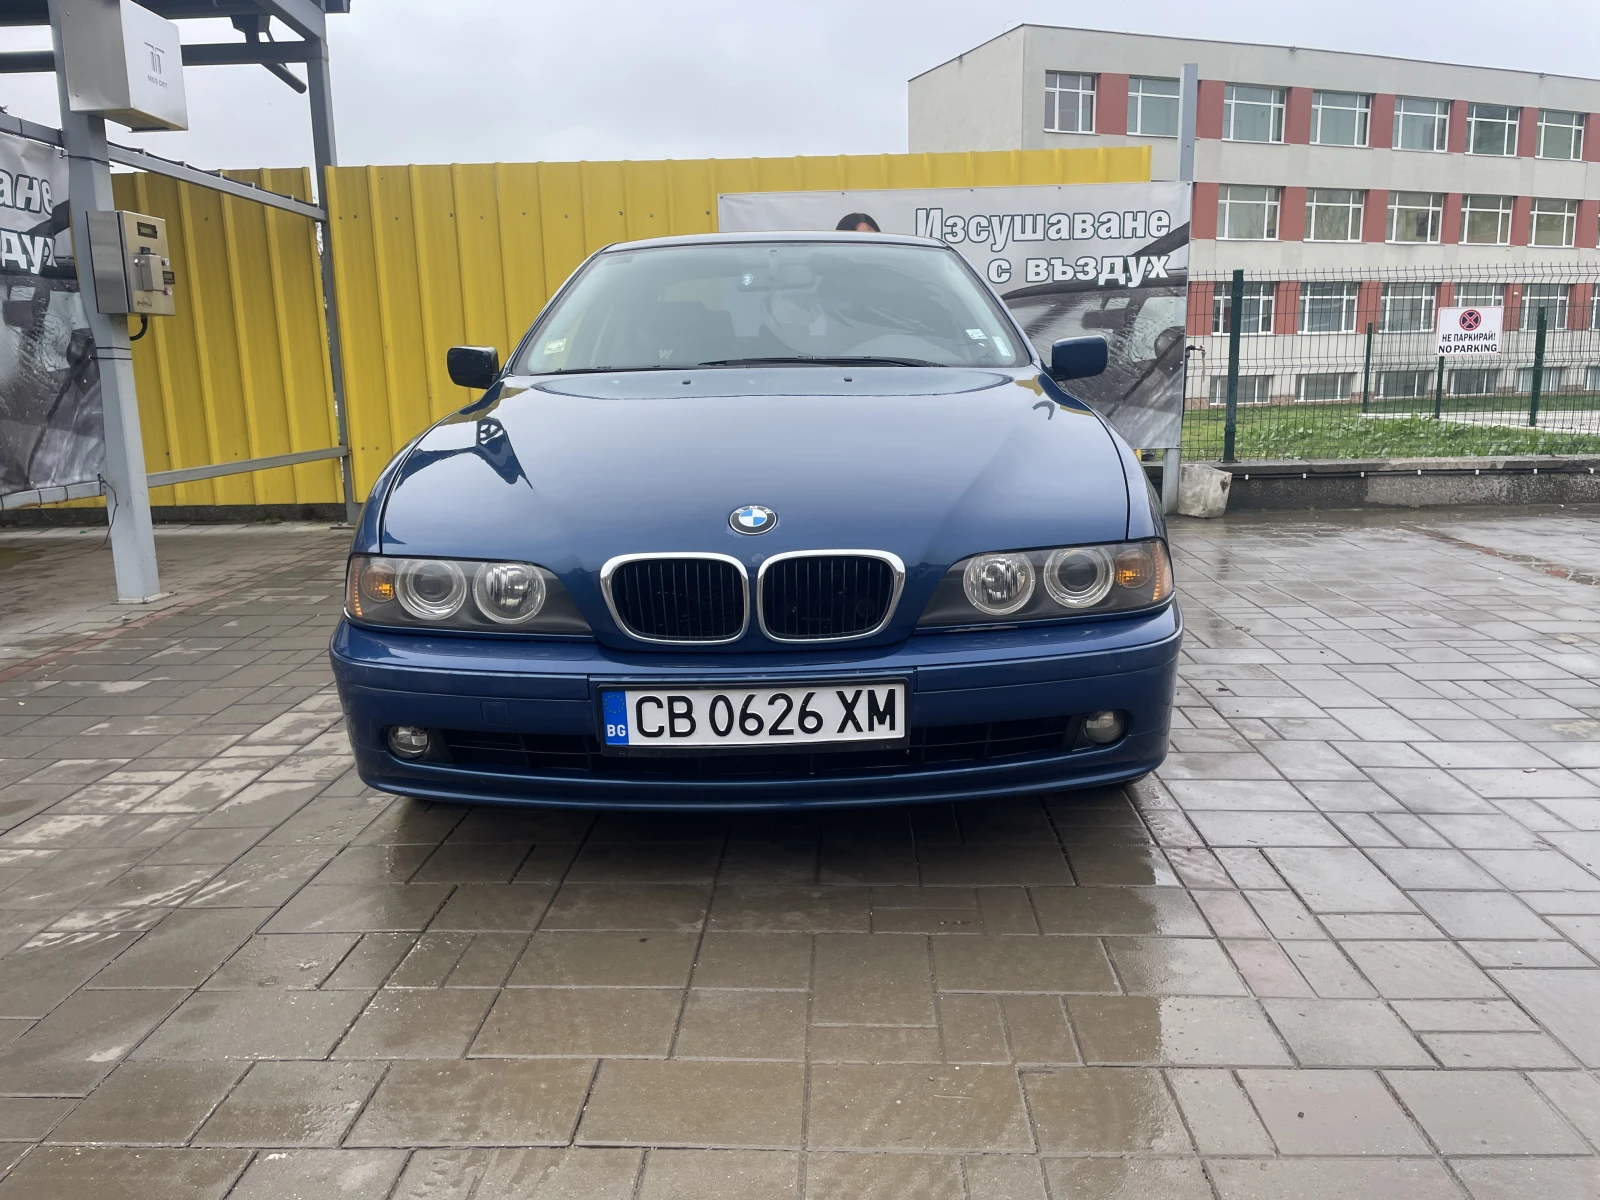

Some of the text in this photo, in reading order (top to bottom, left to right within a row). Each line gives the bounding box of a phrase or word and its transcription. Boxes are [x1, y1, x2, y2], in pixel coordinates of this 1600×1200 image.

[915, 207, 1171, 252] Изсушаване
[987, 254, 1170, 288] с въздух
[1438, 343, 1497, 353] NO PARKING
[1442, 330, 1496, 342] НЕ ПАРКИРАЙ!
[606, 724, 626, 737] BG
[708, 691, 824, 737] 0626
[836, 688, 896, 733] XM
